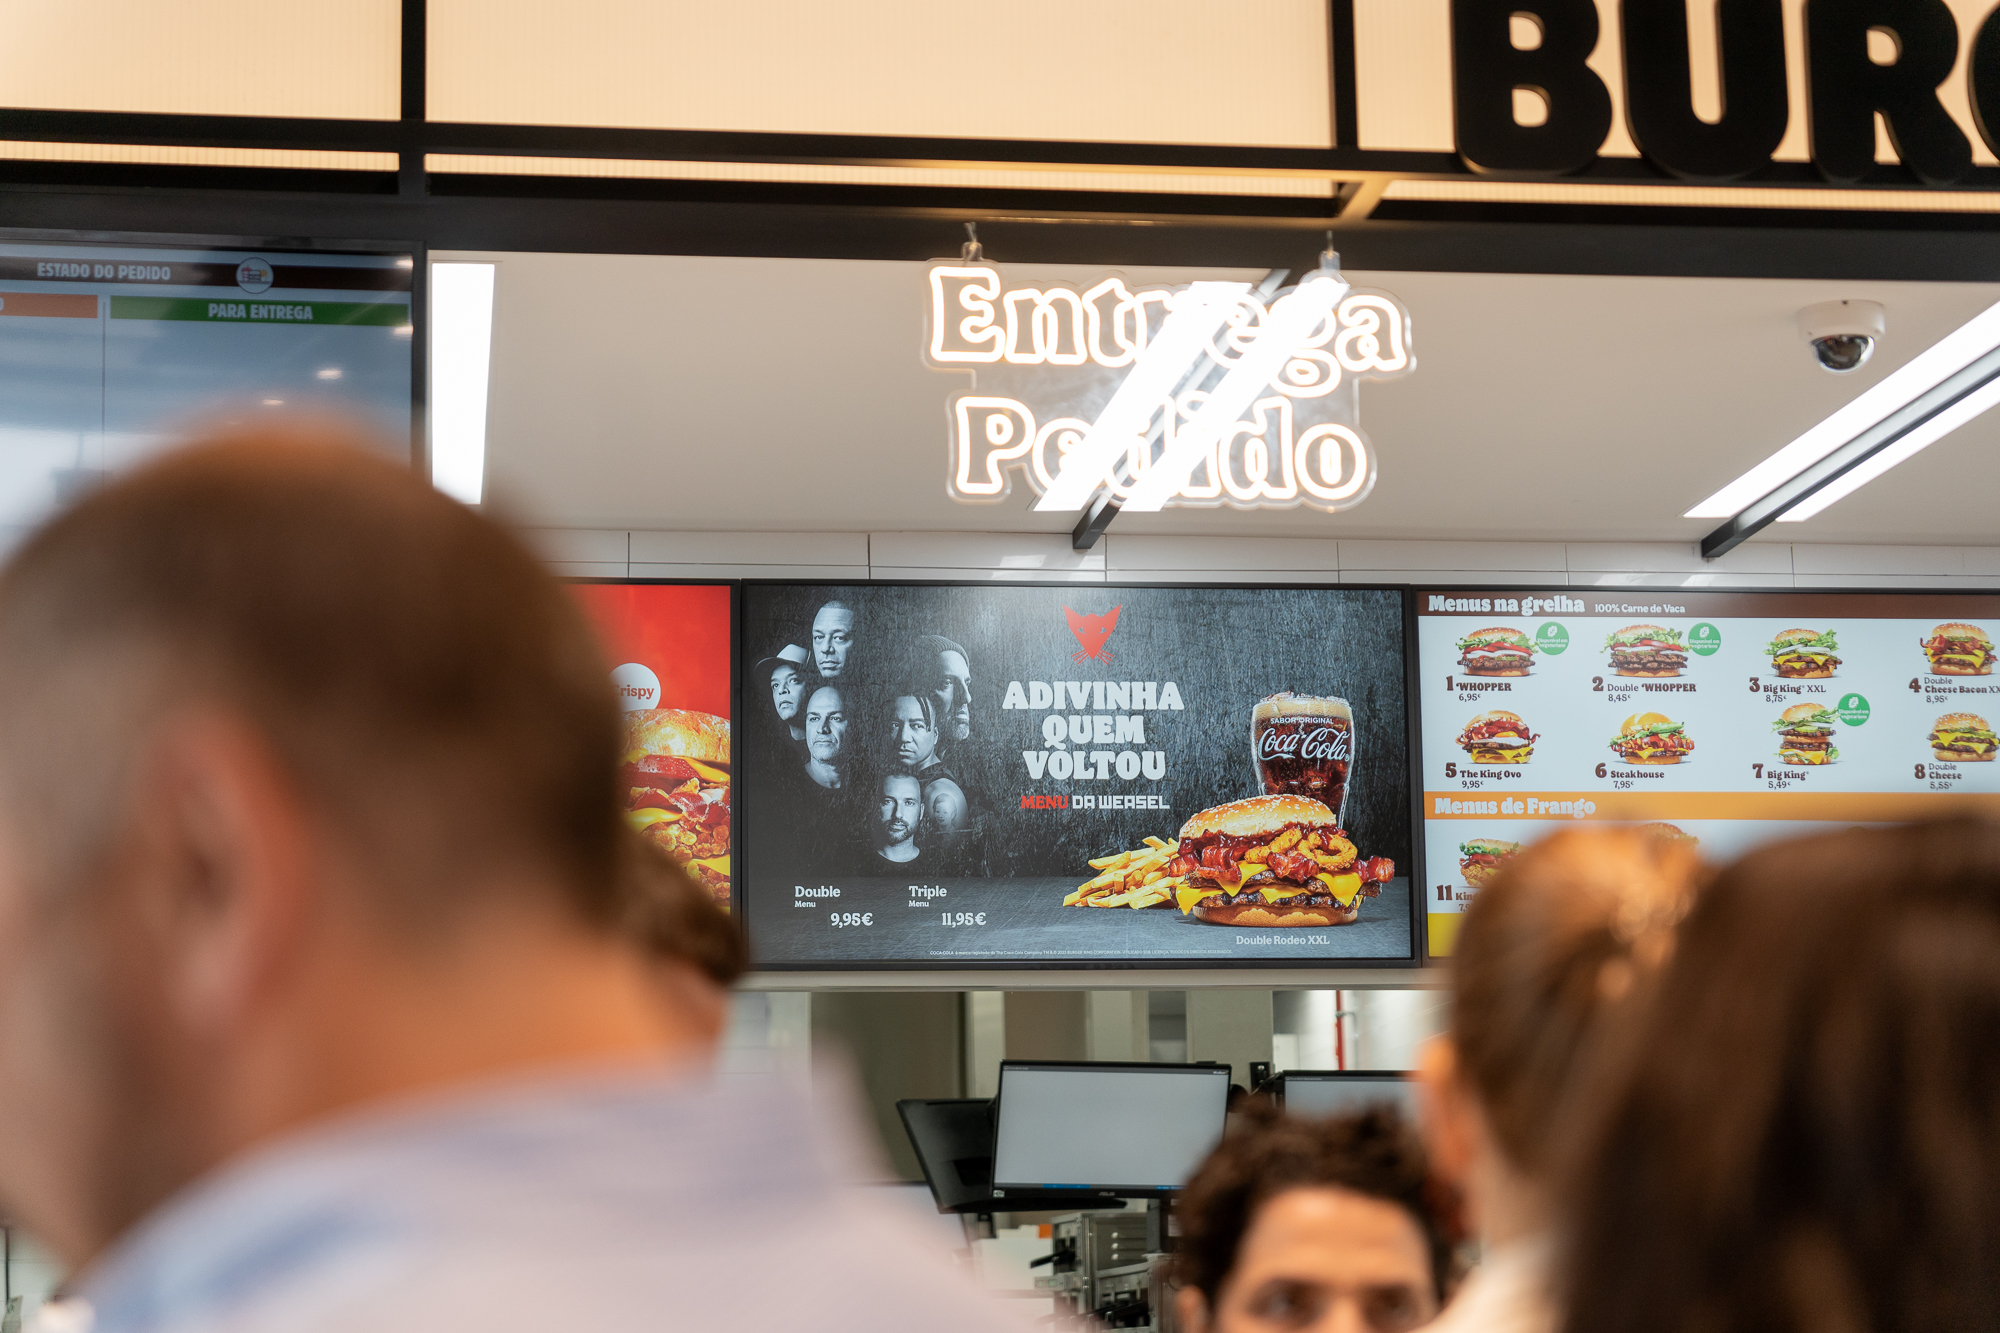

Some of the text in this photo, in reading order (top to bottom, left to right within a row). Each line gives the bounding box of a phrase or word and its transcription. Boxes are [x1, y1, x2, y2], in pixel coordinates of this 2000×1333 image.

[1452, 0, 2000, 185] BUR
[37, 262, 171, 280] ESTADO DO PEDIDO
[208, 303, 313, 320] PARA ENTREGA
[1428, 595, 1585, 616] Menus na grelha
[1595, 603, 1685, 614] 100% Carne de Vaca
[1446, 675, 1512, 691] 1 WHOPPER
[1592, 676, 1697, 692] 2 Double WHOPPER
[1749, 677, 1760, 693] 3
[1763, 684, 1778, 695] Big
[1807, 685, 1826, 693] XXL
[1909, 677, 1953, 693] 4 Double
[1924, 685, 1958, 693] Cheese
[1959, 685, 1988, 694] Bacon
[1002, 681, 1185, 710] ADIVINHA
[1270, 717, 1296, 725] SABOR
[1042, 714, 1146, 750] QUEM
[1022, 750, 1166, 780] VOLTOU
[1445, 762, 1521, 780] 5 The King Ovo
[1595, 762, 1665, 779] 6 Steakhouse
[1752, 764, 1764, 779] 7
[1767, 771, 1782, 781] Big
[1914, 763, 1957, 779] 8 Double
[1929, 771, 1962, 780] Cheese
[1020, 795, 1170, 809] MENU DA WEASEL
[1435, 797, 1597, 819] Menus de Frango
[794, 885, 841, 898] Double
[908, 885, 947, 900] Triple
[1436, 885, 1453, 901] 11
[794, 900, 816, 908] Menu
[908, 900, 930, 908] Menu
[830, 912, 873, 928] 9,95€
[941, 912, 987, 928] 11,95€
[1236, 935, 1331, 945] Double Rodeo XXL
